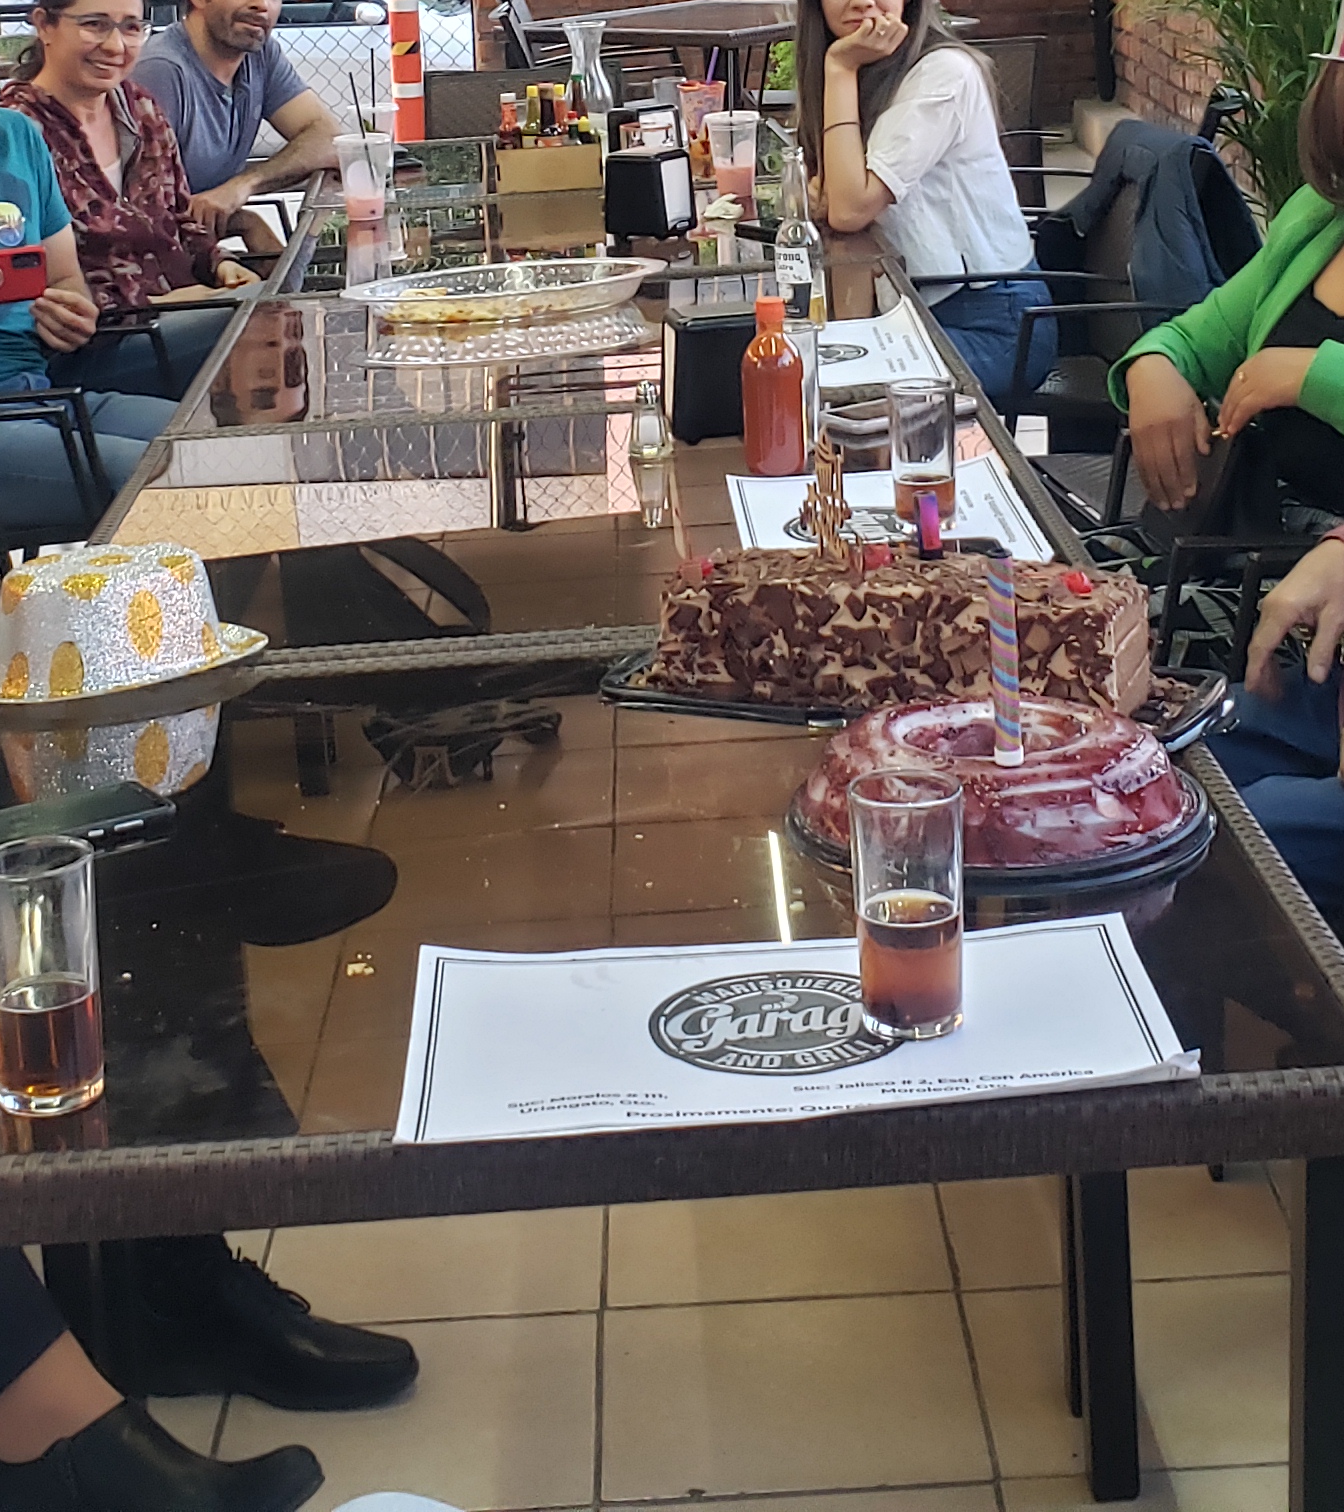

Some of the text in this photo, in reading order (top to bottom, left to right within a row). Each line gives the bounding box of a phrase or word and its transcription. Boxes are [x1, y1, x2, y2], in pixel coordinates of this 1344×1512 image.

[692, 978, 862, 1005] MARISQUERIA
[665, 1002, 863, 1052] Garag
[713, 1050, 782, 1069] AND
[834, 1081, 896, 1089] Jalisco
[550, 1092, 621, 1103] Morelos
[626, 1106, 793, 1118] Proximamente:
